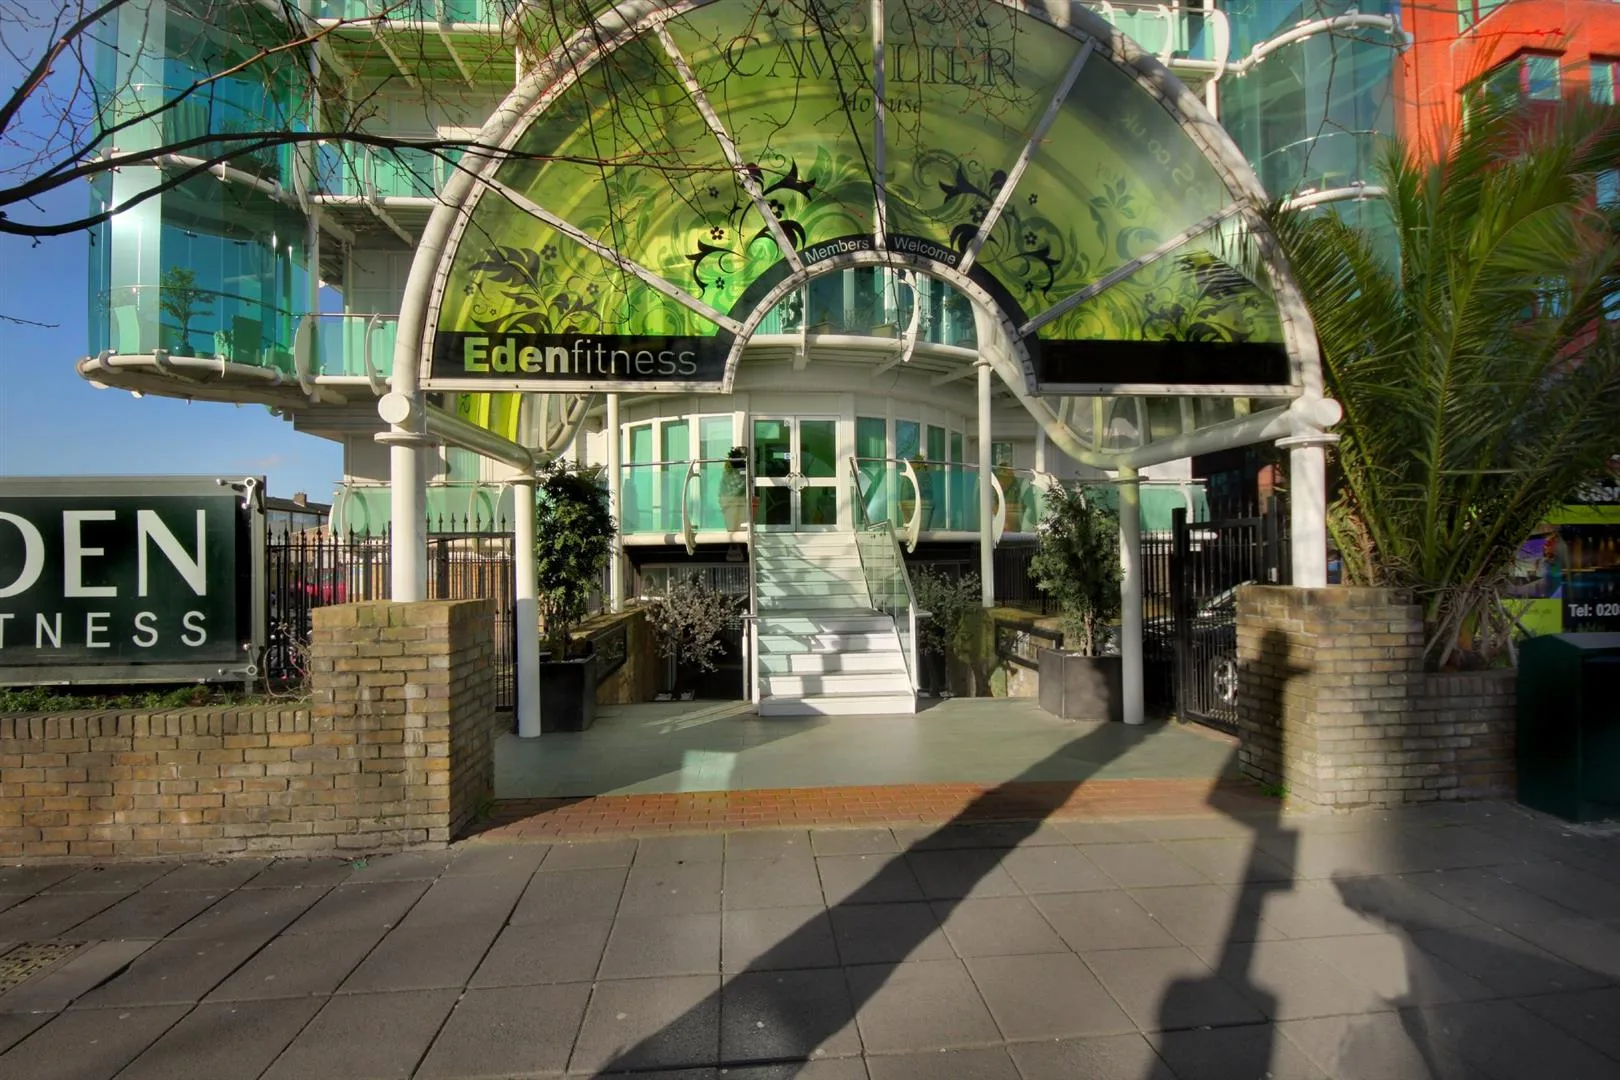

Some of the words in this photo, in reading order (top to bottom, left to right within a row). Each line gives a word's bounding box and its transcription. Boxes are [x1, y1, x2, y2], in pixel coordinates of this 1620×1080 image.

[724, 35, 1021, 88] CAVALIER
[804, 238, 870, 264] Members
[894, 236, 957, 265] Welcome
[1567, 603, 1593, 617] Tel:
